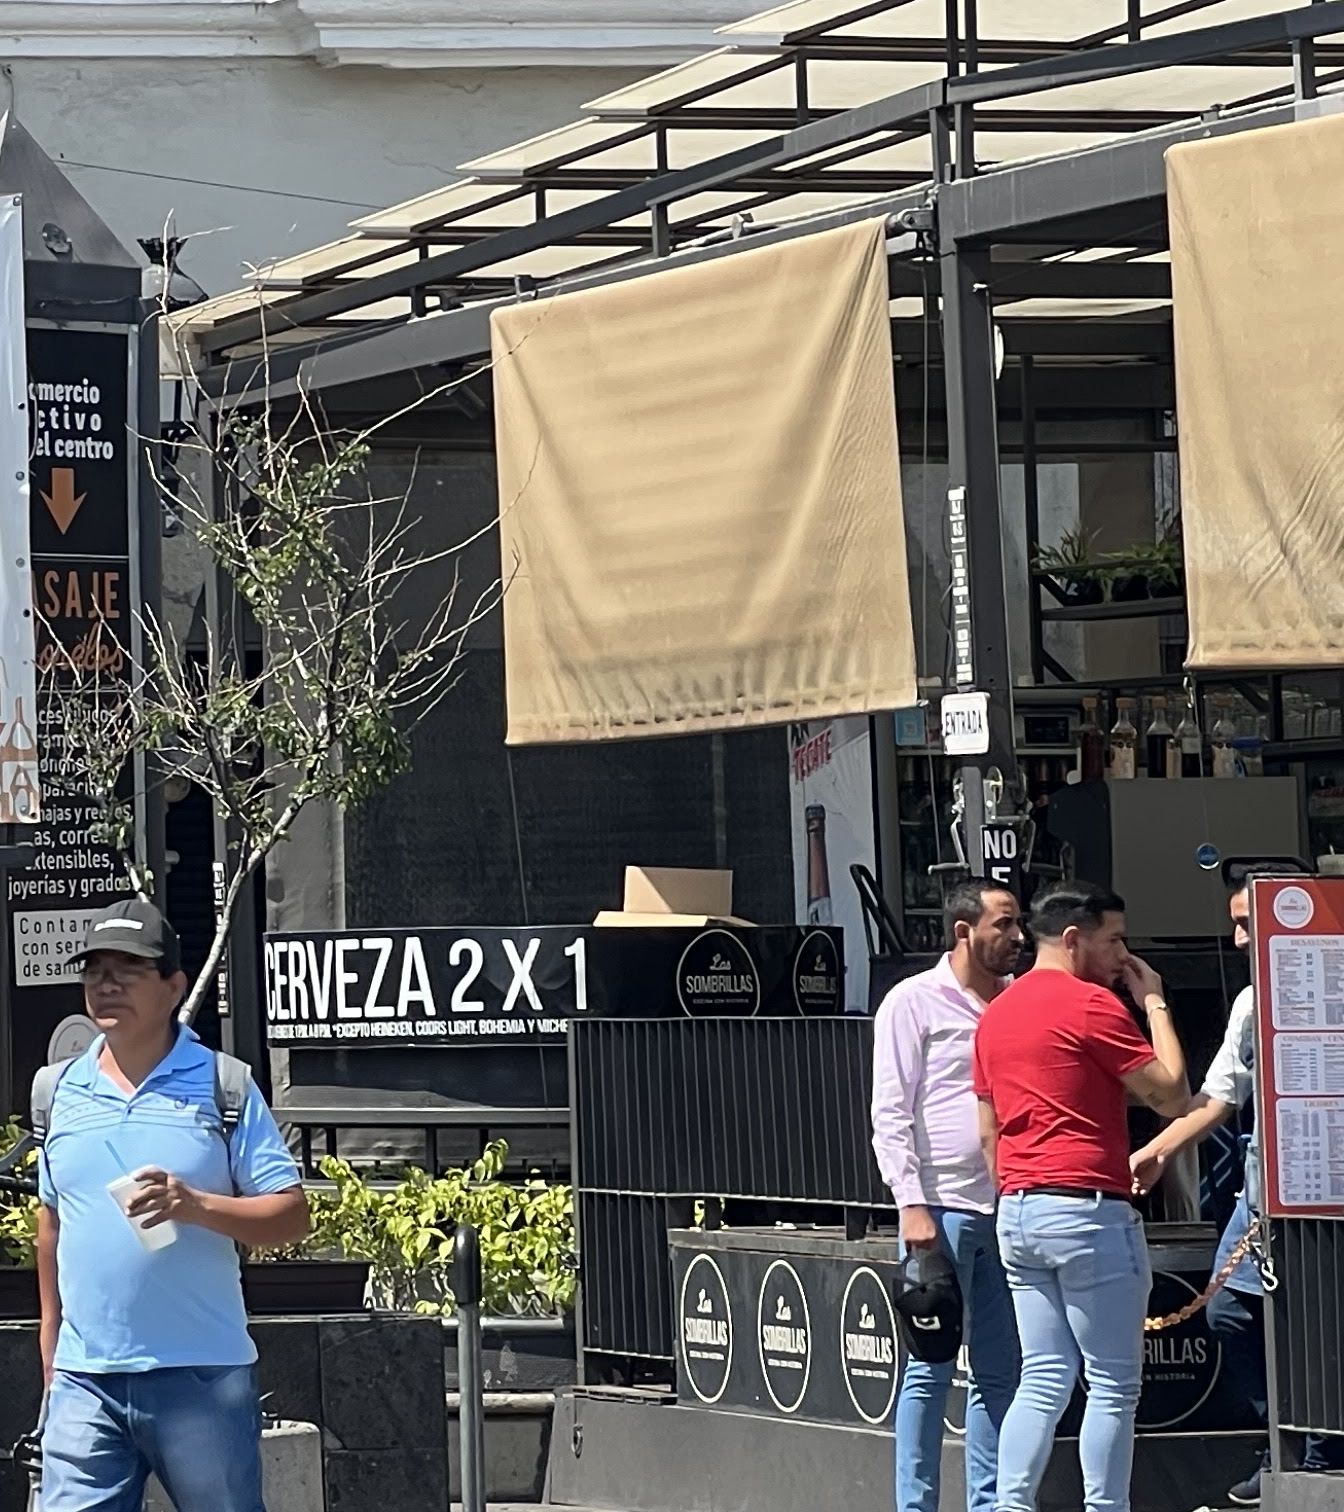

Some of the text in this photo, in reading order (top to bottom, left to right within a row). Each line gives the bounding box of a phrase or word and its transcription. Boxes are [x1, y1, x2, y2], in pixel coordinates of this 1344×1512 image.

[29, 378, 100, 404] omercio
[38, 404, 102, 431] ctivo
[54, 437, 114, 459] centro
[32, 569, 120, 619] SAJE
[946, 711, 983, 735] ENTRADA
[74, 808, 82, 824] y
[983, 829, 1017, 859] NO
[25, 849, 114, 870] xtensibles,
[68, 879, 77, 898] y
[22, 940, 49, 955] con
[23, 962, 41, 977] de
[710, 953, 732, 971] Las
[264, 937, 436, 1021] CERVEZA
[448, 938, 484, 1012] 2
[502, 938, 543, 1011] X
[564, 937, 587, 1010] 1
[686, 975, 754, 994] SOMBRILLAS
[415, 1020, 448, 1036] COORS
[448, 1019, 479, 1035] LIGHT,
[479, 1019, 526, 1035] BOHEMIA
[527, 1019, 535, 1033] Y
[1143, 1337, 1207, 1364] RILLAS
